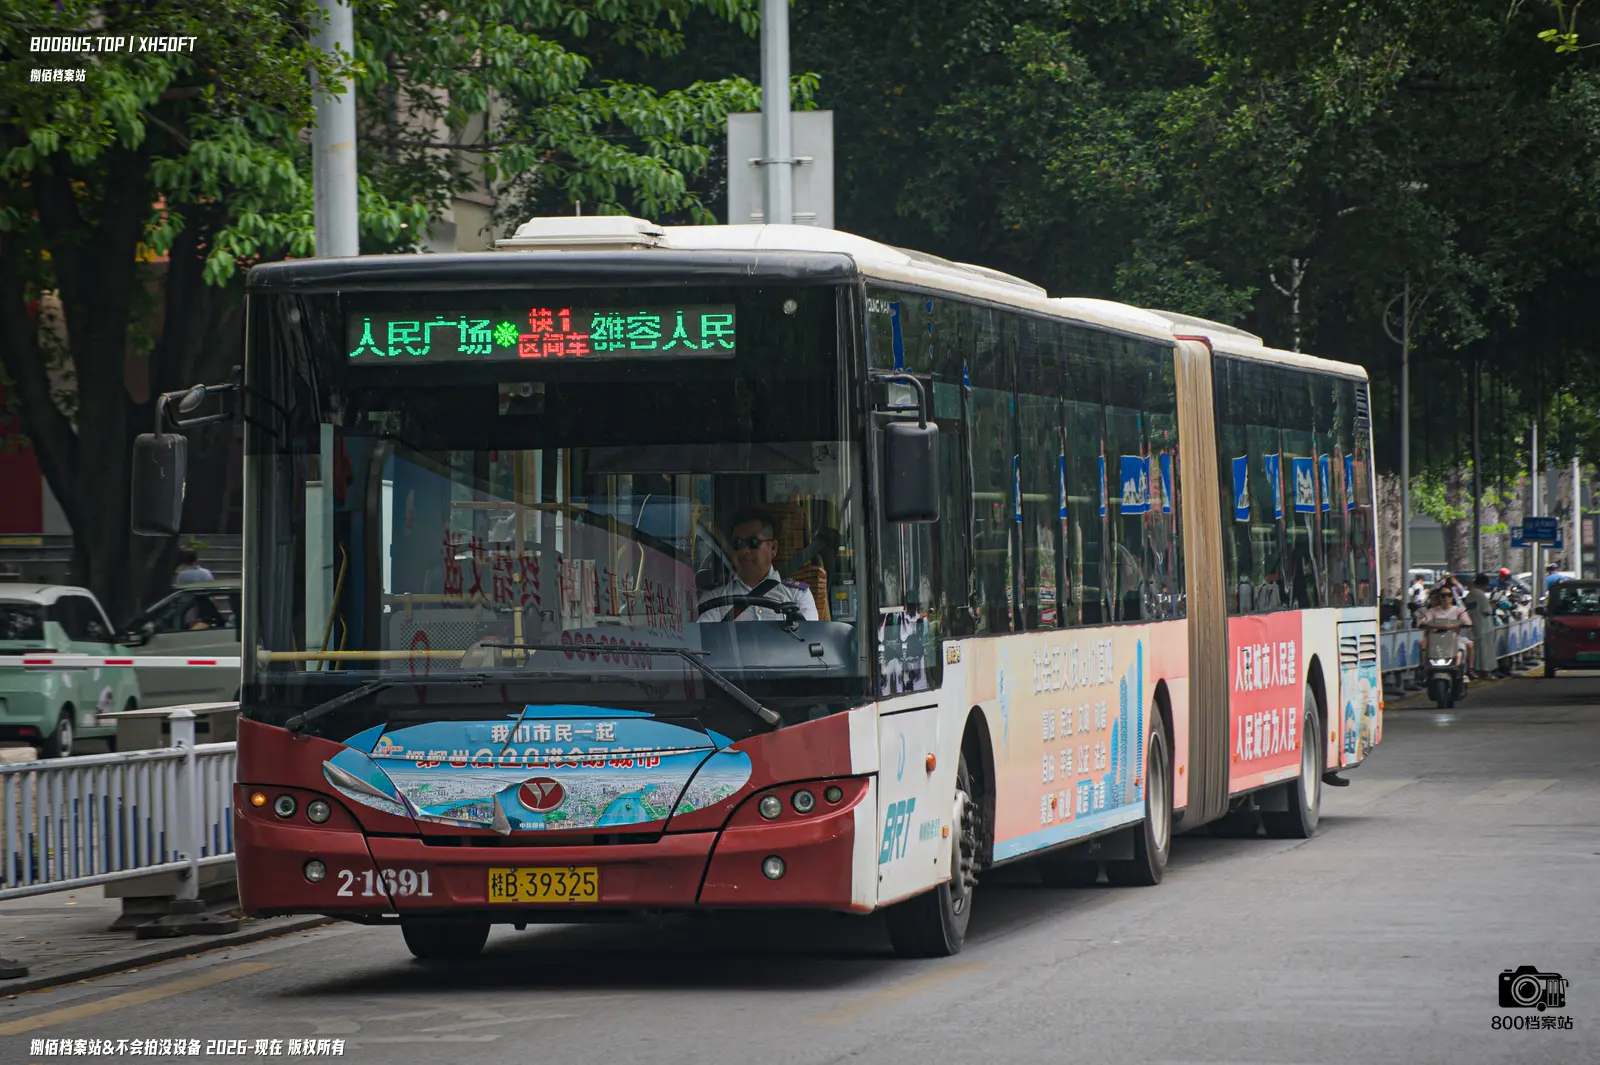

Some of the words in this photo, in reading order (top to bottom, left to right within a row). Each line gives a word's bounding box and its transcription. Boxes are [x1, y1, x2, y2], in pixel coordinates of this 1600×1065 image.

[349, 315, 493, 358] 人民广场
[518, 331, 591, 358] 区间车
[1235, 639, 1296, 692] 人民城市人民建
[491, 723, 616, 744] 我们市民一起
[1236, 706, 1296, 760] 人民城市为人民
[878, 797, 916, 865] BRT
